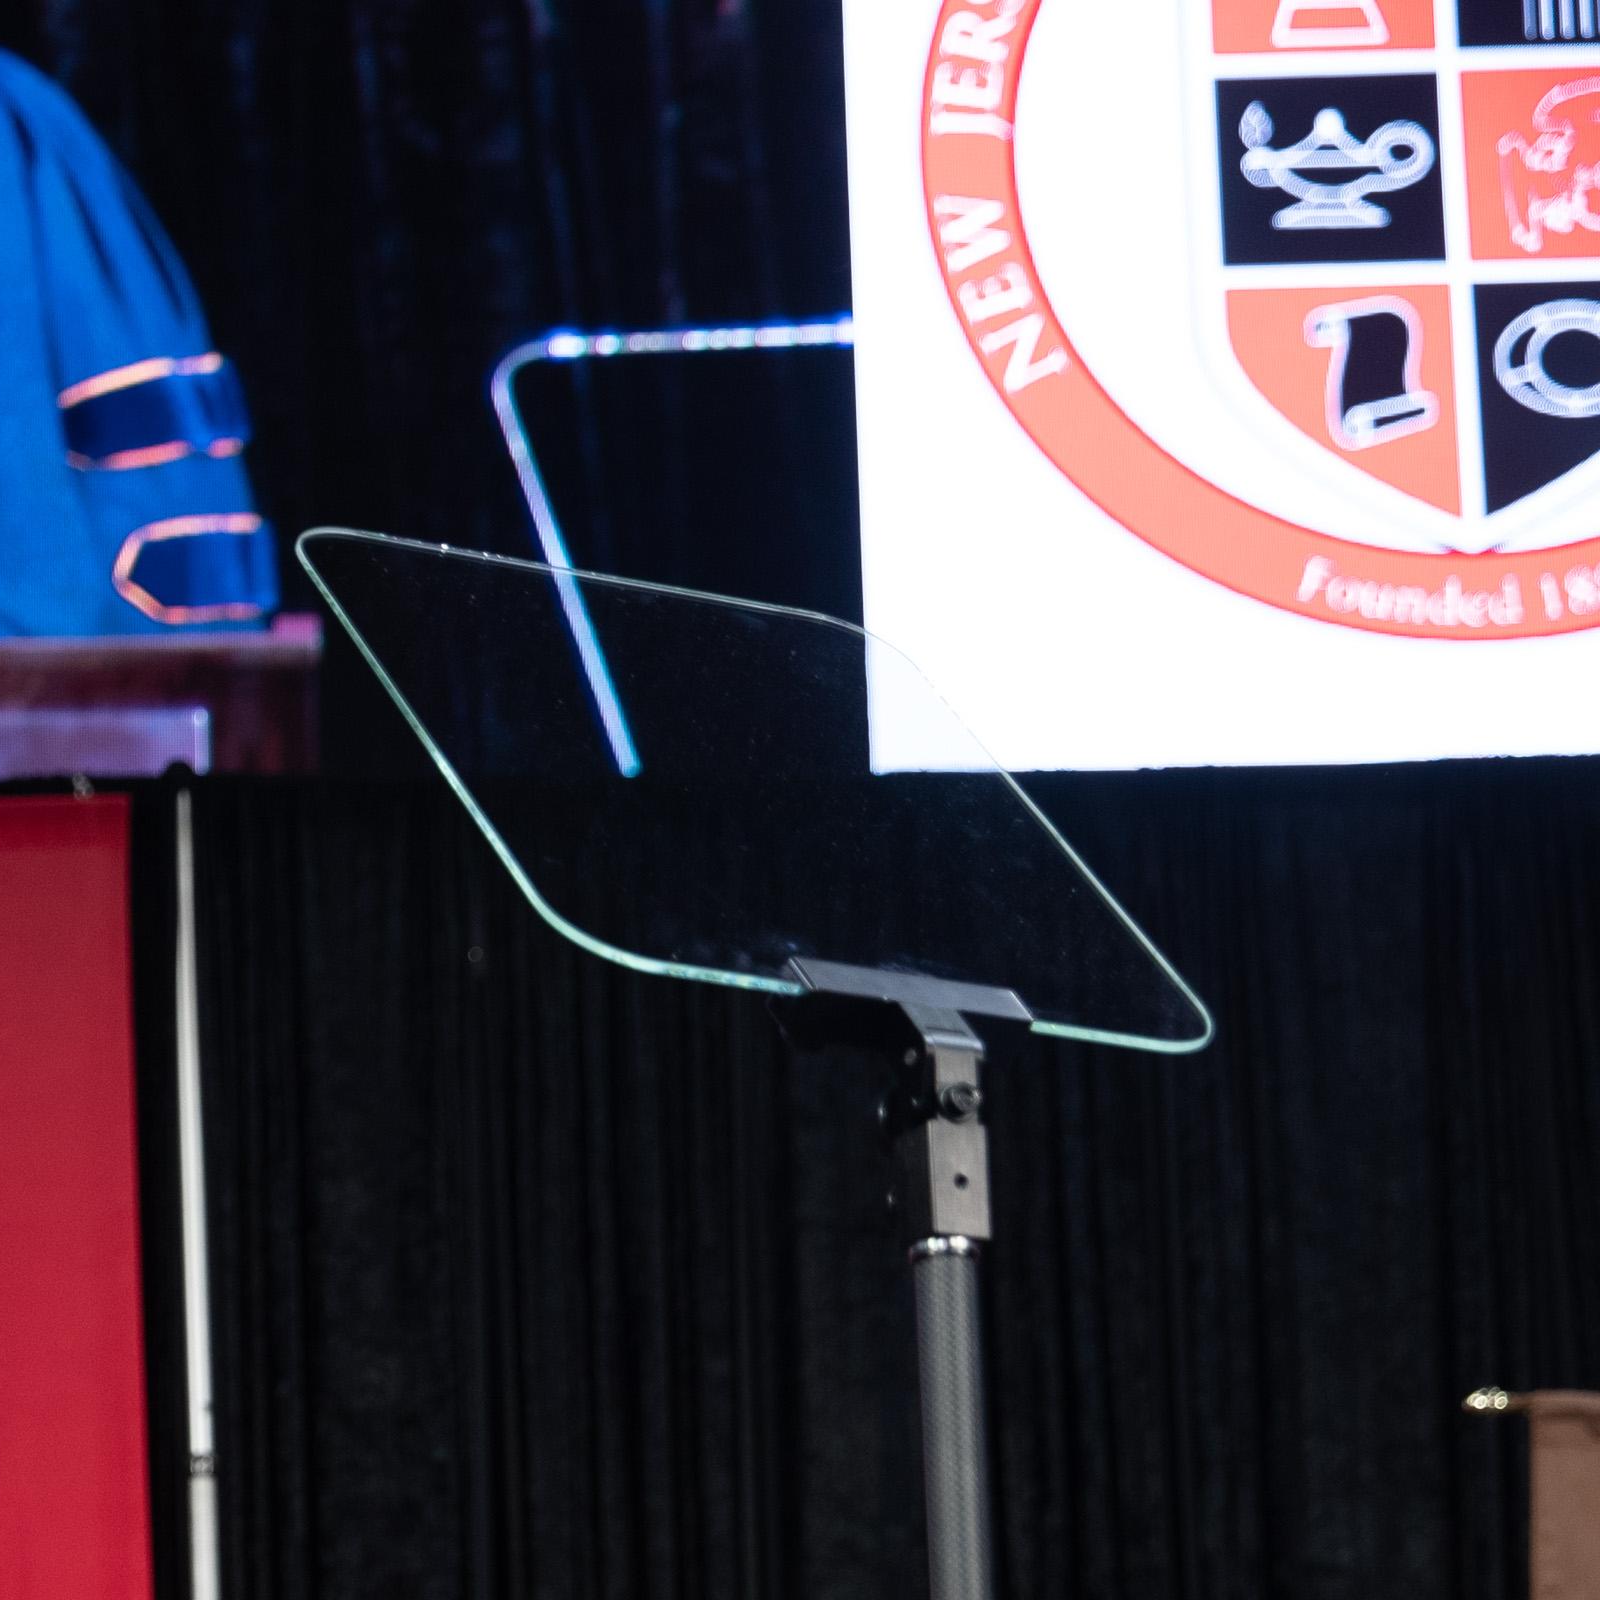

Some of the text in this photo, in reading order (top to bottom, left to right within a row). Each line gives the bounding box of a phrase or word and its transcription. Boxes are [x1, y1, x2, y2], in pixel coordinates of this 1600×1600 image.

[933, 193, 1070, 394] NEW
[1297, 555, 1600, 627] Founded 18
